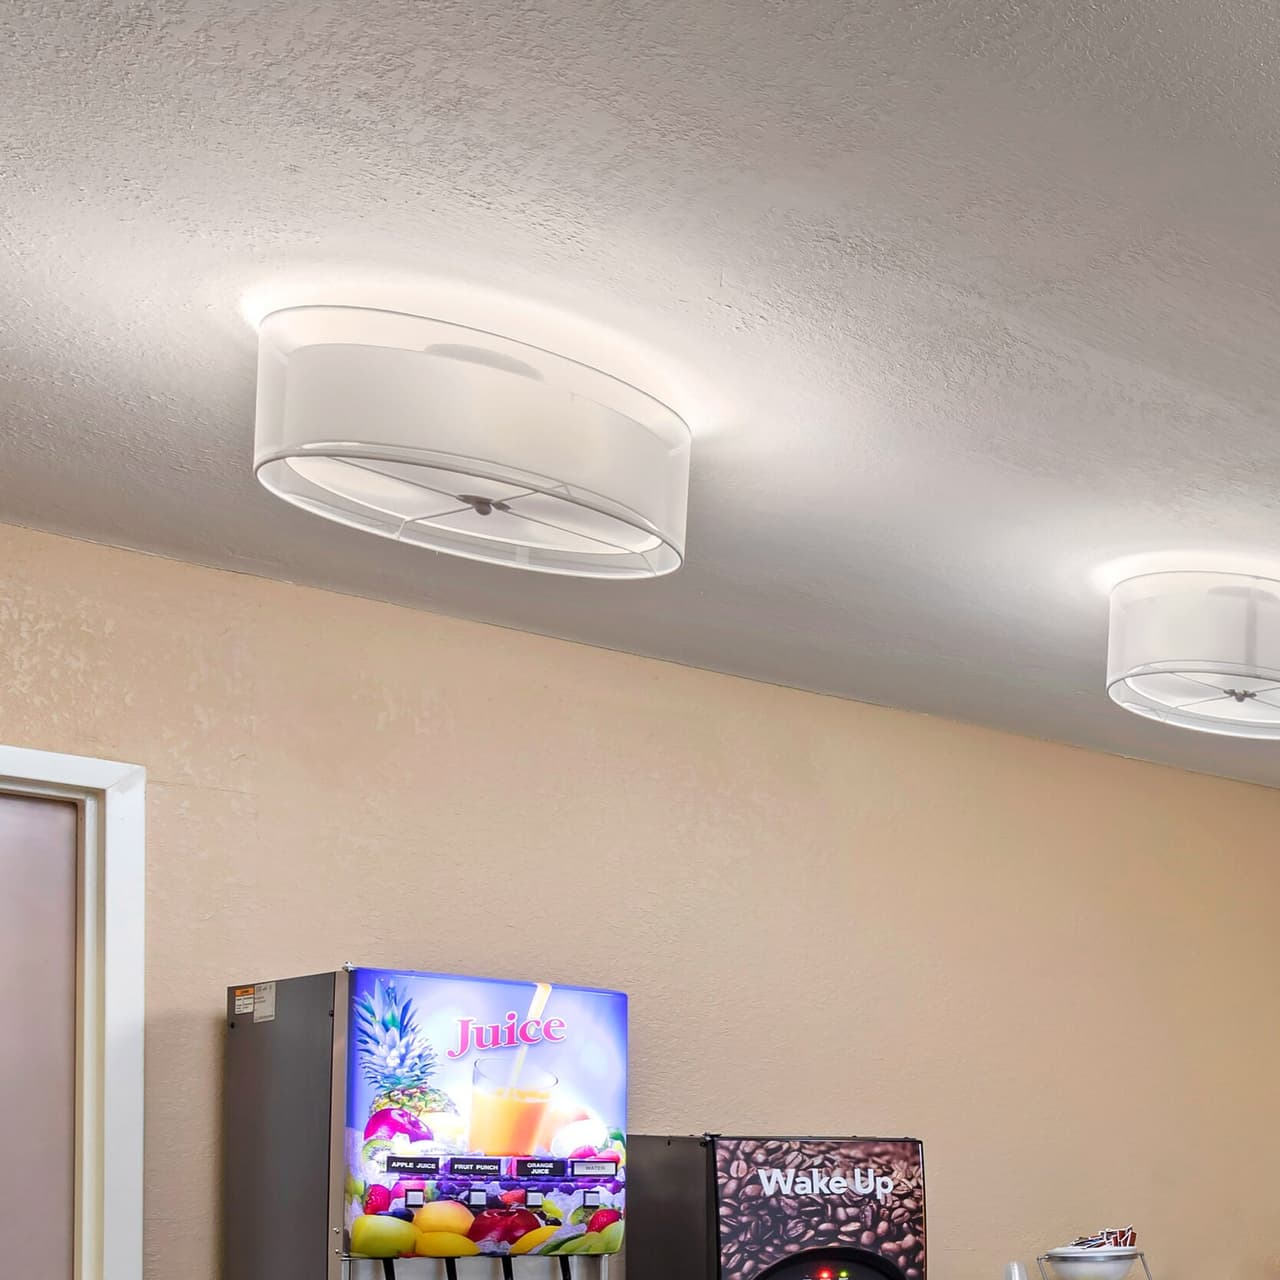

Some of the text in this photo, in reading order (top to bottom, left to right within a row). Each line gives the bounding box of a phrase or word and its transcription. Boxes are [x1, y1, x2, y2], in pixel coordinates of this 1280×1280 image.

[446, 1011, 567, 1059] Juice
[391, 1161, 414, 1169] APPLE
[757, 1168, 894, 1200] Wake Up
